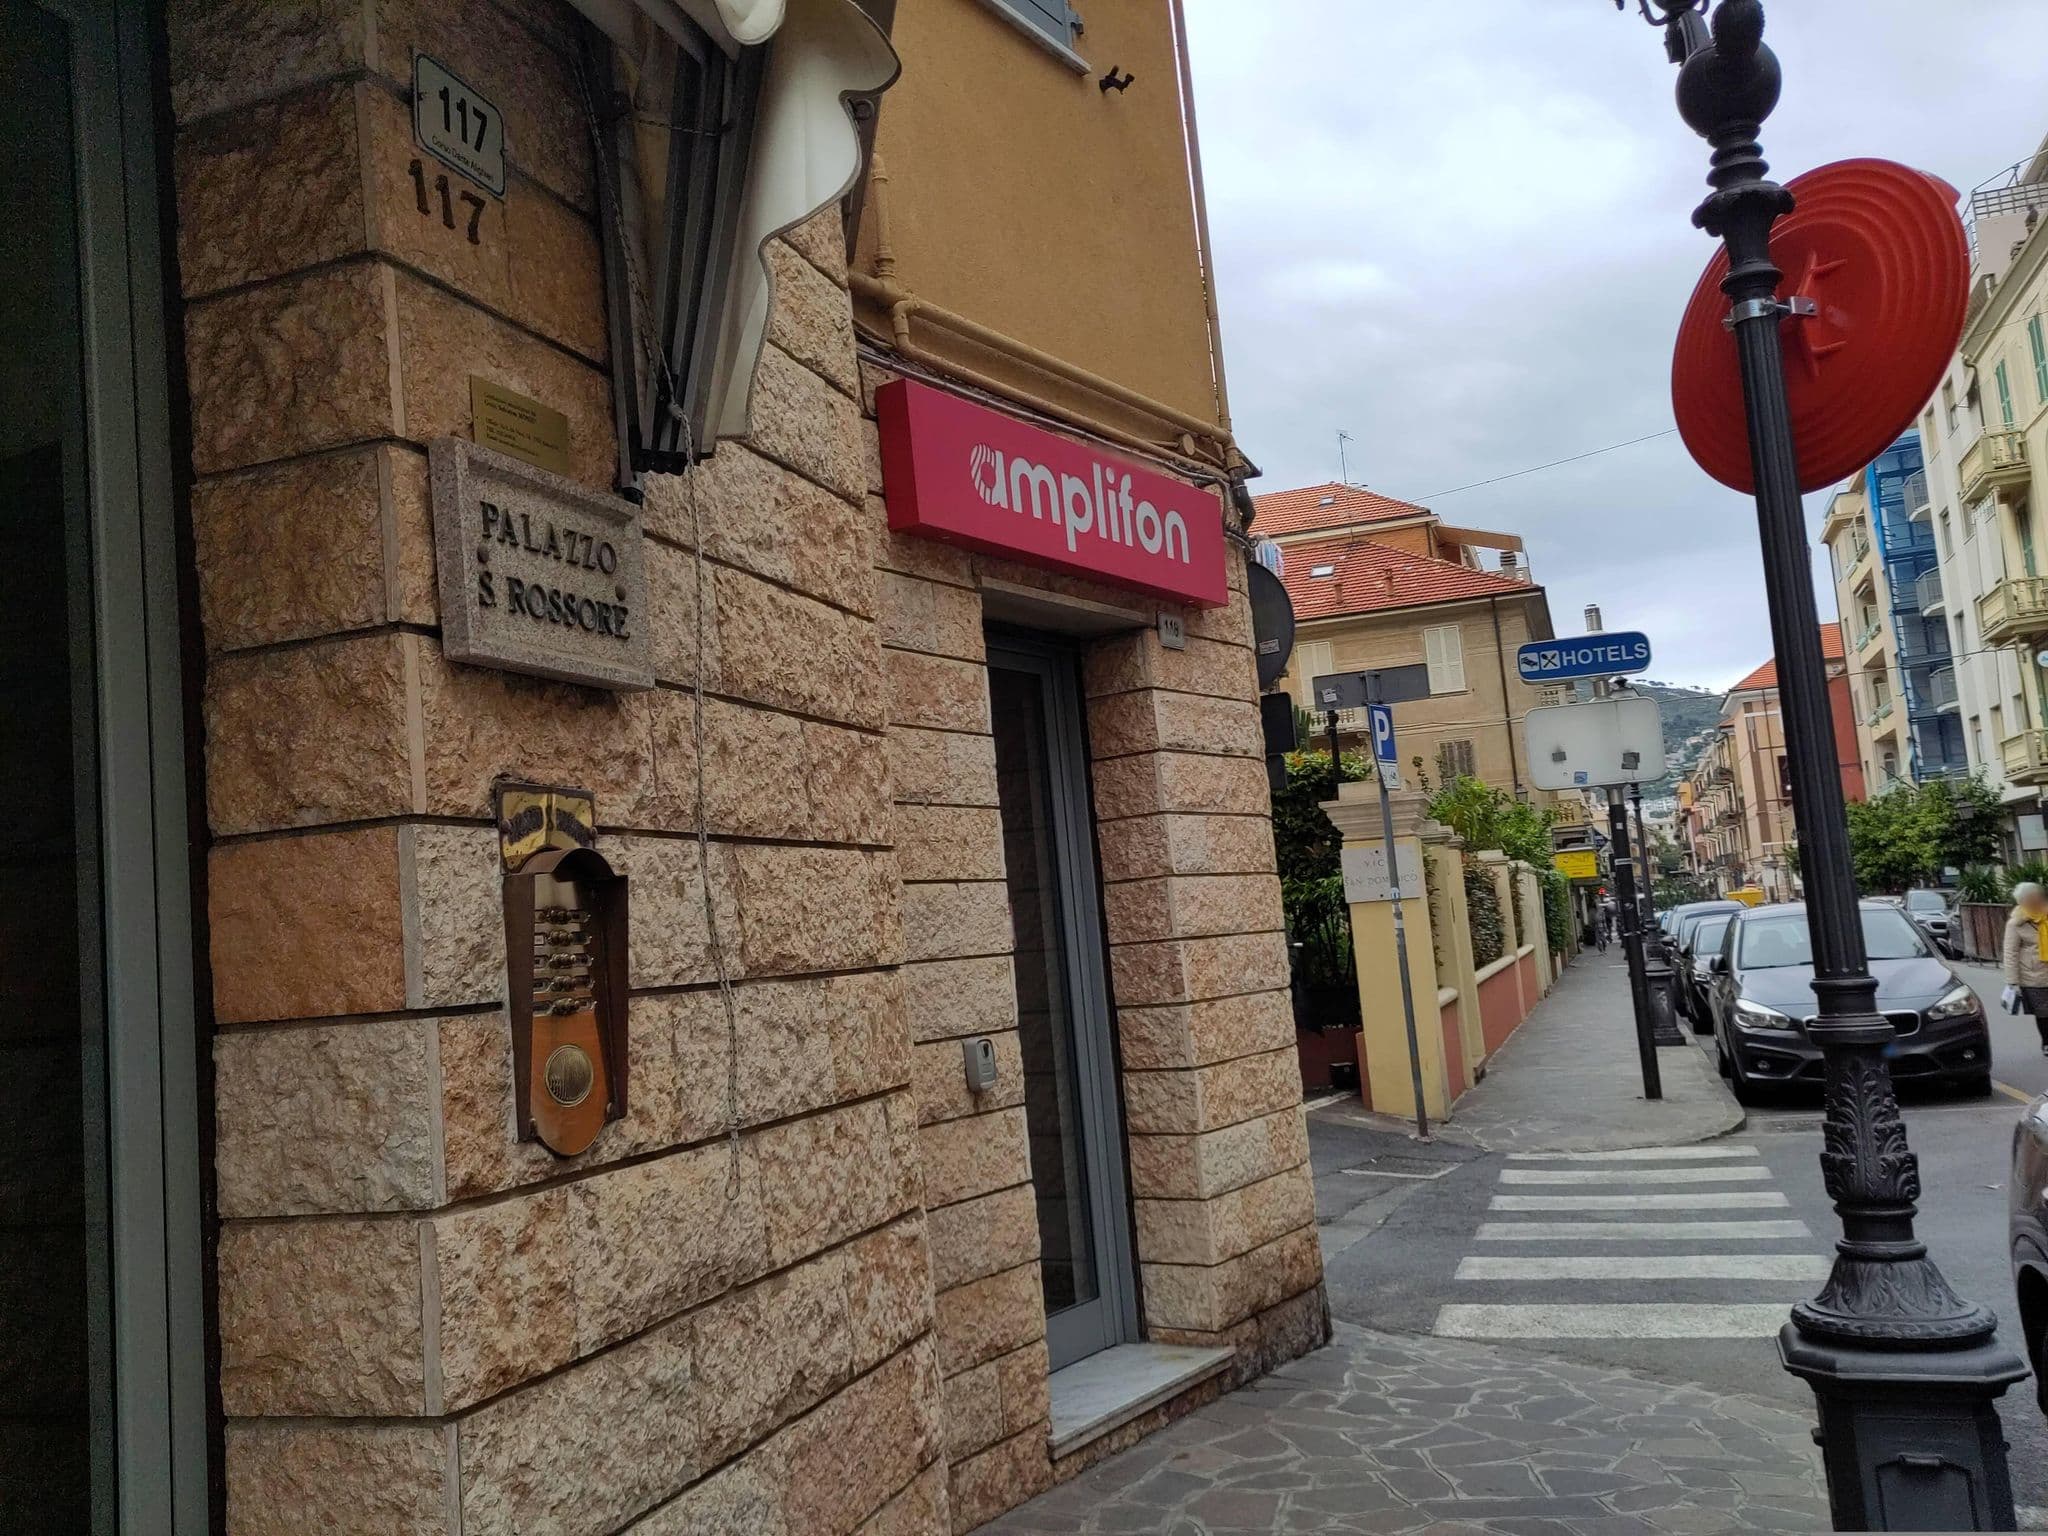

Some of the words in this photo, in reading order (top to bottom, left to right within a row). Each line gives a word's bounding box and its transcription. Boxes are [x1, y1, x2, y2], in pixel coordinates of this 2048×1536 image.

[439, 86, 488, 153] 117
[408, 158, 486, 246] 117
[970, 443, 1190, 564] amplifon
[479, 500, 617, 575] PALAZZO
[506, 576, 631, 640] ROSSORE
[1562, 643, 1649, 667] HOTELS
[1373, 710, 1391, 756] P
